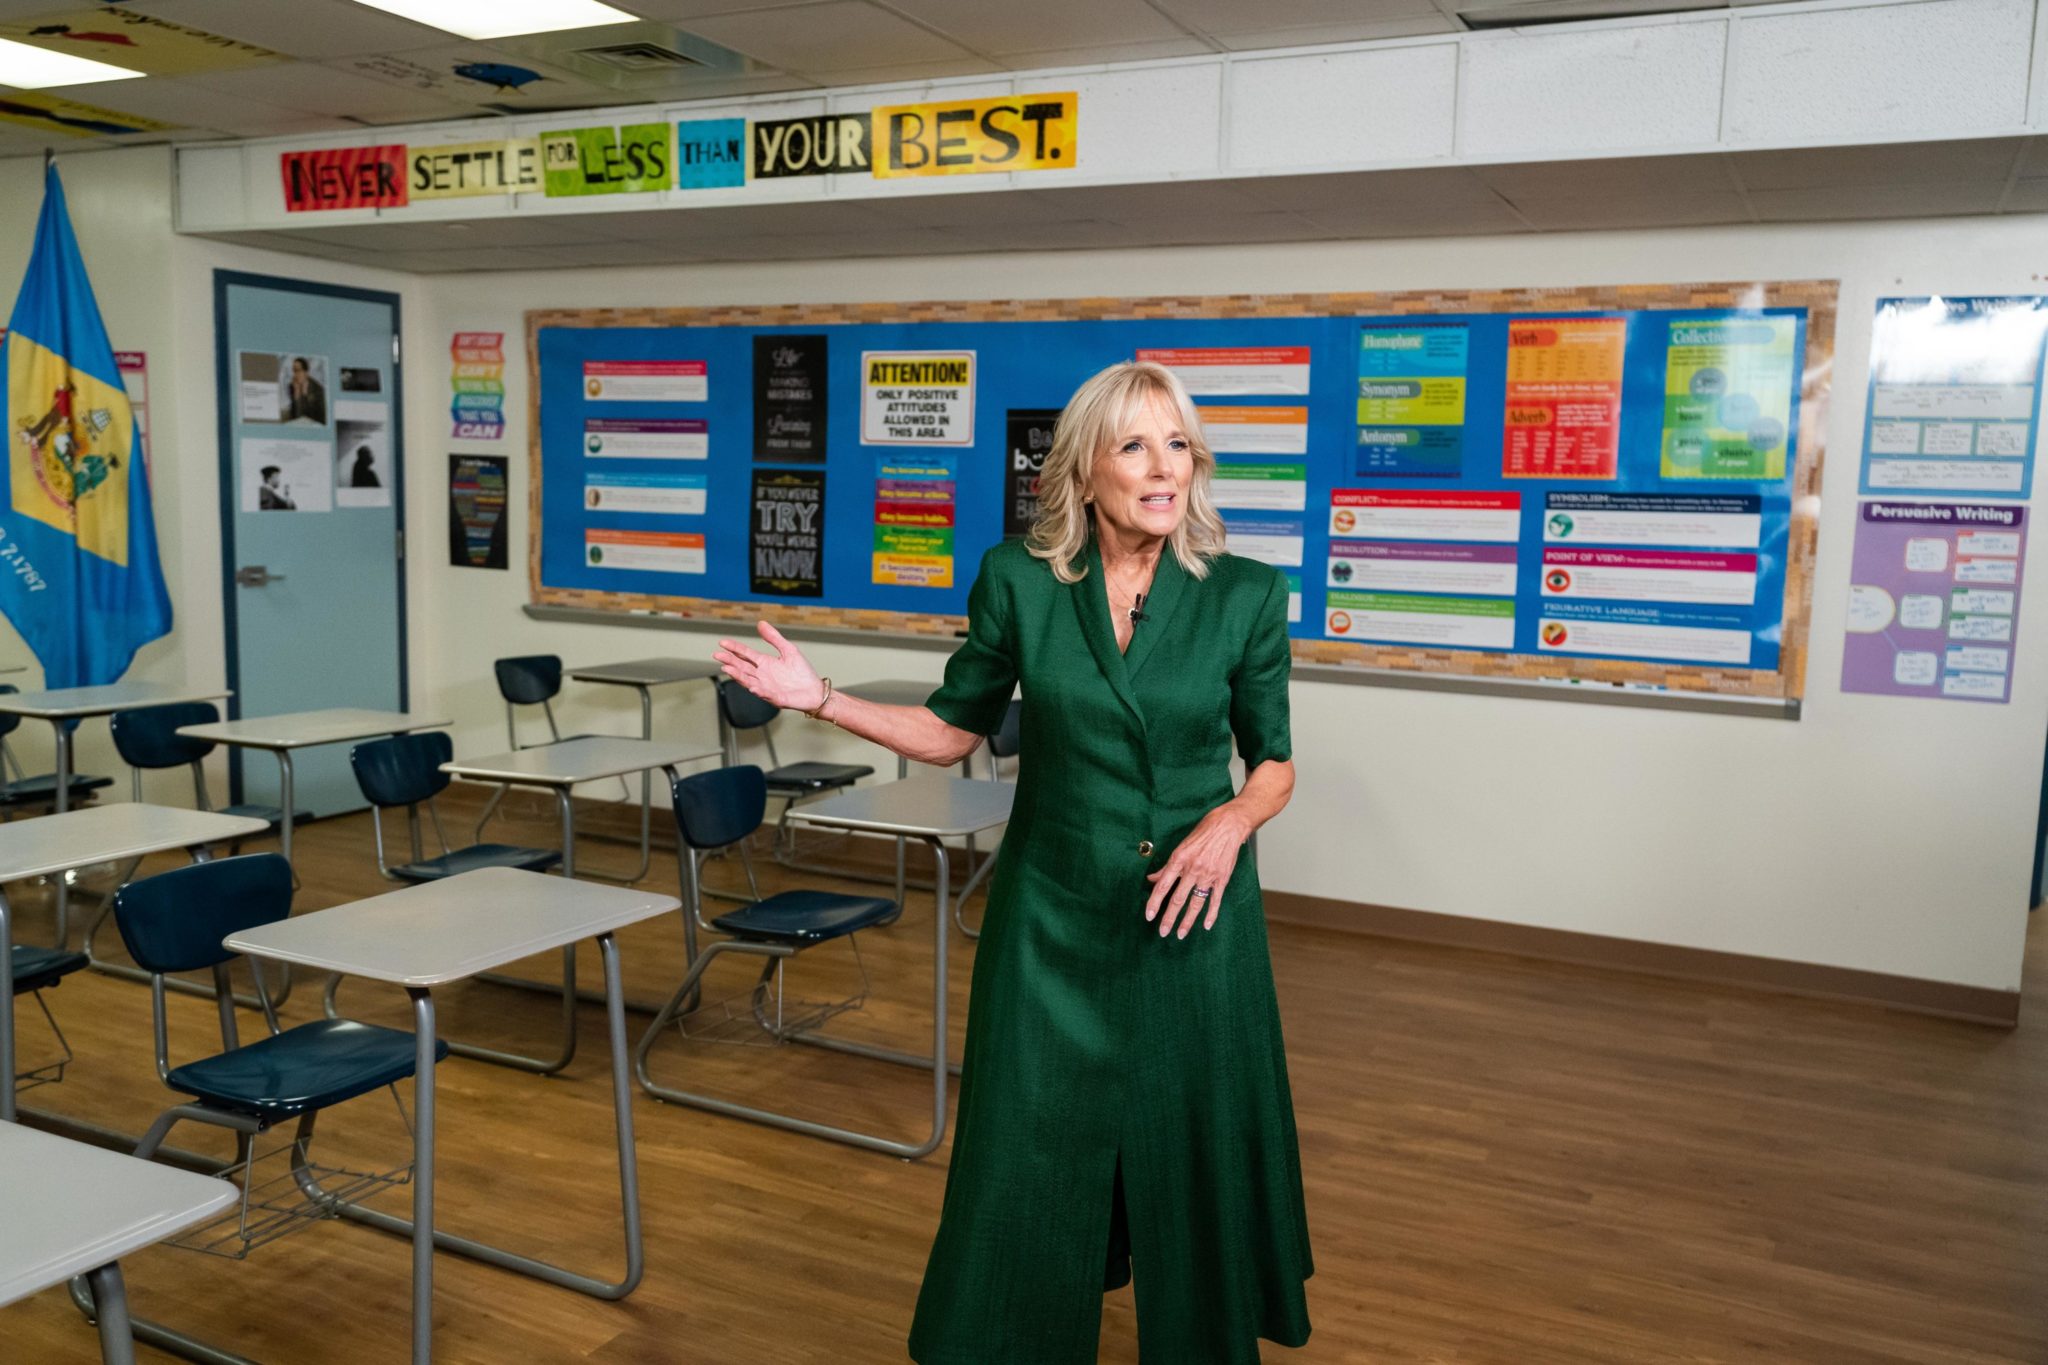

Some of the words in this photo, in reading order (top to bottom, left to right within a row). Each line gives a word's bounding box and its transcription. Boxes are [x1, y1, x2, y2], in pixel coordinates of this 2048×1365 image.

[291, 152, 398, 203] NEVER
[414, 148, 538, 190] SETTLE
[547, 143, 577, 163] FOR
[583, 141, 665, 184] LESS
[681, 140, 740, 165] THAN
[759, 119, 868, 171] YOUR
[889, 103, 1063, 170] BEST.
[1363, 334, 1423, 350] Homophone
[1512, 332, 1538, 345] Verb
[870, 362, 967, 383] ATTENTION!
[767, 389, 813, 400] MISTAKES
[876, 390, 904, 400] ONLY
[908, 390, 959, 401] POSITIVE
[1361, 382, 1410, 398] Synonym
[887, 402, 947, 413] ATTITUDES
[883, 415, 936, 425] ALLOWED
[938, 416, 951, 426] IN
[1510, 409, 1547, 423] Adverb
[460, 424, 499, 437] CAN
[888, 427, 913, 438] THIS
[916, 428, 946, 438] AREA
[1359, 429, 1408, 445] Antonym
[1720, 447, 1753, 457] cluster
[768, 487, 787, 500] YOU
[788, 488, 819, 501] NEVER
[1333, 495, 1379, 504] CONFLICT:
[1871, 504, 1952, 519] Persuasive
[1956, 507, 2014, 523] Writing
[787, 536, 817, 549] NEVER
[1546, 552, 1577, 561] POINT
[1579, 553, 1593, 561] OF
[1597, 554, 1627, 563] VIEW:
[888, 564, 925, 573] becomes
[927, 567, 945, 576] your
[1544, 602, 1603, 614] FIGURATIVE
